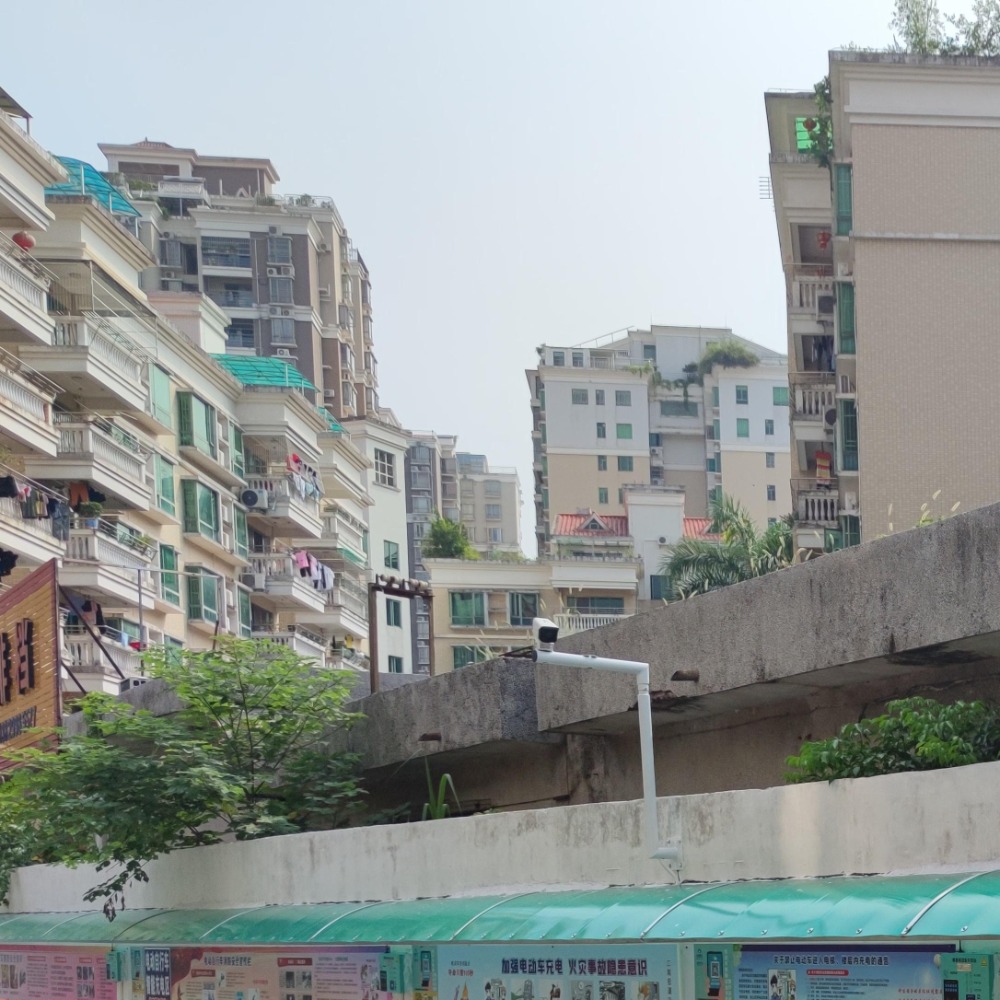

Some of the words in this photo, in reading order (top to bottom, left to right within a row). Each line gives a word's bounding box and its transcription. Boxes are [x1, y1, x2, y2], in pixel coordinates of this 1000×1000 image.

[501, 957, 563, 975] 加强电动车充电
[567, 959, 648, 977] 火灾事故隐患意识
